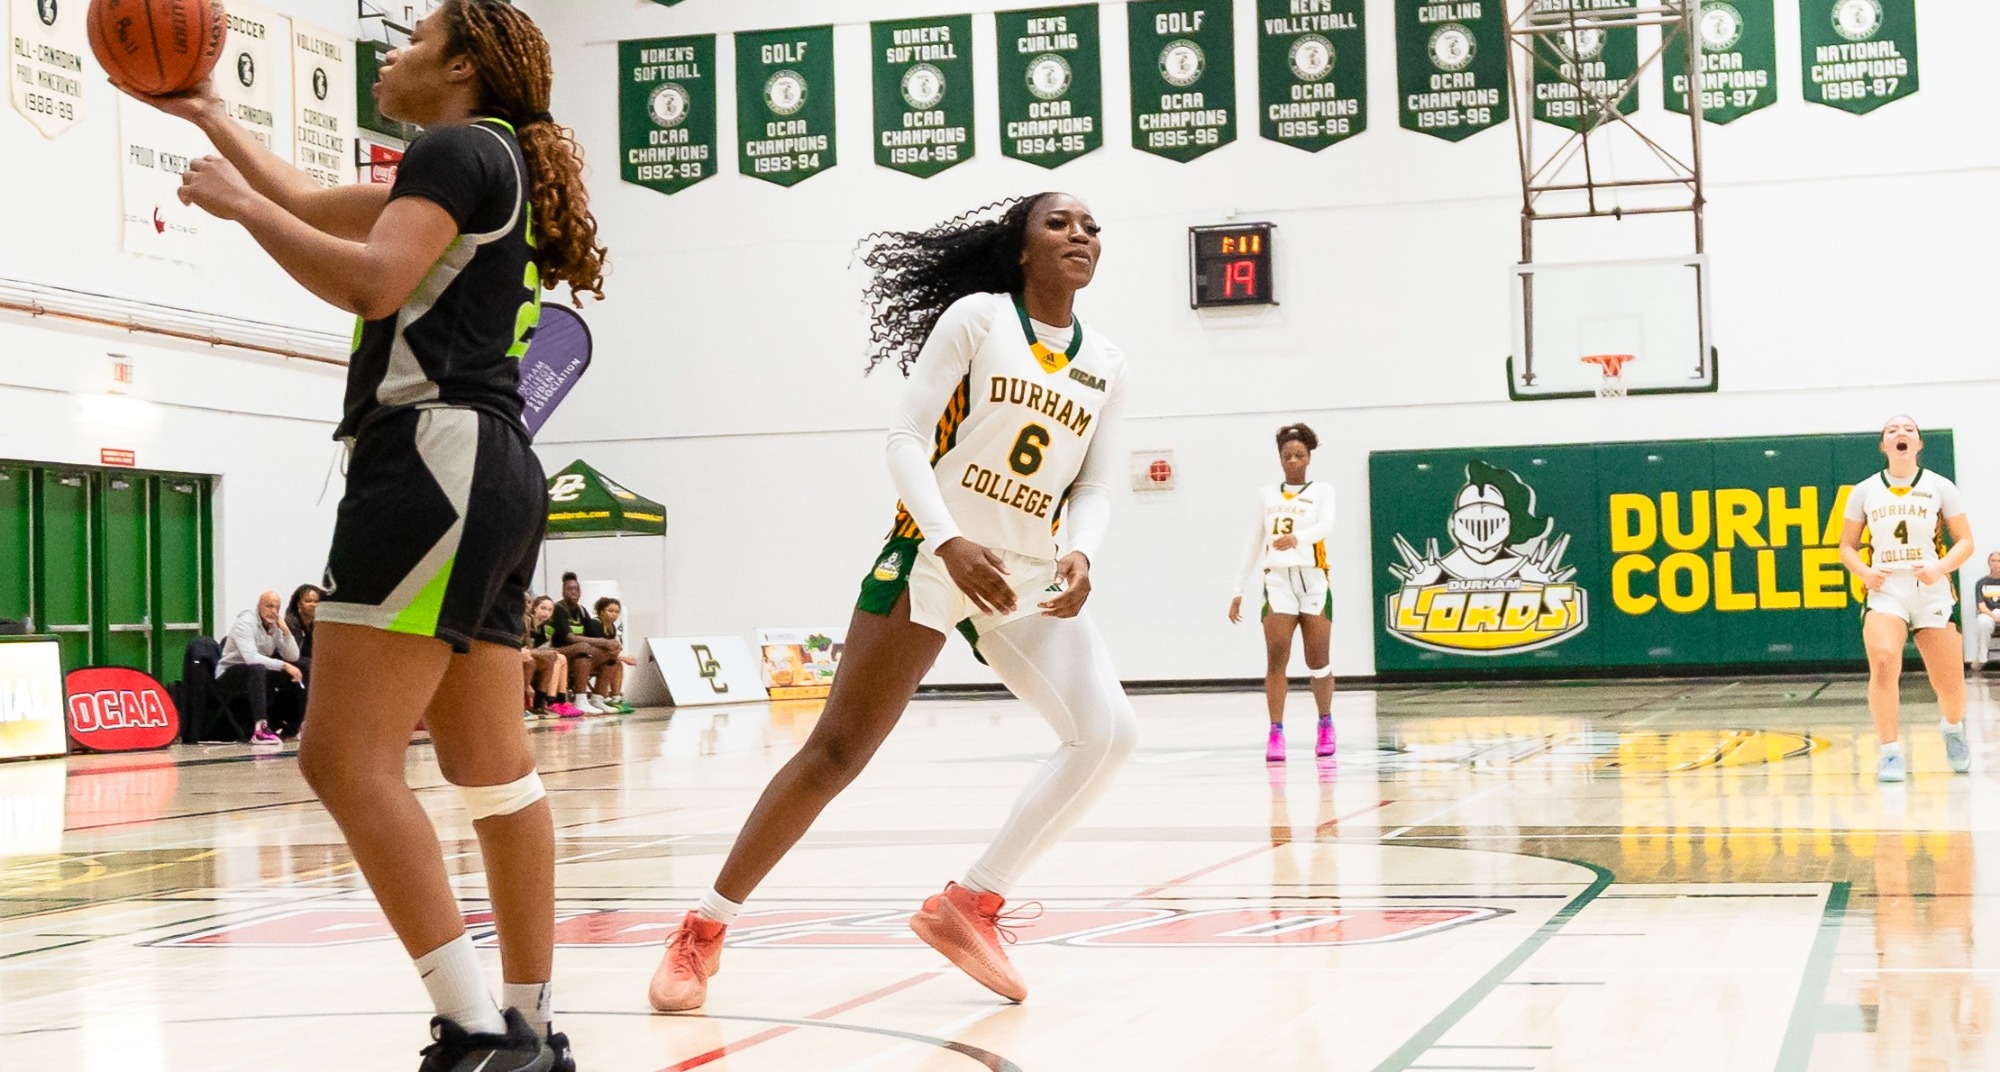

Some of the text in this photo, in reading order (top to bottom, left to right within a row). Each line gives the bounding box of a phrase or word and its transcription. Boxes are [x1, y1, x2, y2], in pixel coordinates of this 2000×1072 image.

[1156, 10, 1205, 35] GOLF
[1418, 2, 1482, 23] CURLING
[225, 13, 265, 40] SOCCER
[1027, 16, 1067, 34] MEN'S
[1264, 12, 1357, 35] VOLLEYBALL
[893, 26, 950, 45] WOMEN'S
[1017, 34, 1078, 54] CURLING
[15, 37, 81, 73] ALL-CANADIAN
[640, 47, 694, 65] WOMEN'S
[761, 42, 807, 64] GOLF
[886, 43, 957, 64] SOFTBALL
[1816, 40, 1900, 63] NATIONAL
[633, 63, 701, 82] SOFTBALL
[1430, 72, 1475, 90] OCAA
[1673, 70, 1768, 92] CAMPIONS
[1811, 58, 1907, 83] CHAMPIONS
[1291, 82, 1335, 101] OCAA
[1408, 88, 1499, 110] CHAMPIONS
[1822, 78, 1899, 100] 1996-97
[1029, 100, 1071, 119] OCAA
[1161, 92, 1204, 111] OCAA
[1269, 99, 1358, 121] CHAMPIONS
[1683, 90, 1758, 111] 196-97
[903, 110, 945, 128] OCAA
[1007, 116, 1093, 138] CHAMPIONS
[1139, 109, 1227, 131] CHAMPIONS
[1418, 107, 1490, 127] 1995-96
[649, 129, 689, 145] OCAA
[767, 120, 807, 138] OCAA
[882, 127, 965, 148] CHAMPIONS
[1148, 128, 1219, 148] 1995-96
[1278, 118, 1349, 138] 1995-96
[628, 145, 708, 164] CHAMPIONS
[746, 135, 828, 157] CHAMPIONS
[890, 146, 957, 164] 1994-95
[1016, 135, 1085, 155] 1994-95
[637, 163, 702, 181] 1992-93
[754, 153, 820, 173] 1993-94
[1223, 260, 1255, 297] 19
[524, 364, 555, 400] OLLEGE
[526, 372, 558, 408] STUDENT
[533, 357, 581, 413] ASSOCIATION
[1069, 367, 1107, 393] OCAA
[989, 376, 1092, 438] DURHAM
[1006, 421, 1052, 478] 6
[961, 463, 1053, 519] COLLEGE
[1610, 485, 1869, 552] DURHA
[1871, 504, 1928, 522] DURHAM
[1272, 516, 1294, 535] 13
[1893, 520, 1909, 545] 4
[1881, 548, 1923, 563] COLLEGE
[1449, 579, 1521, 591] DURHAM
[1611, 547, 1870, 615] COLLE
[1396, 583, 1575, 632] LORDS
[69, 690, 168, 732] OCAA
